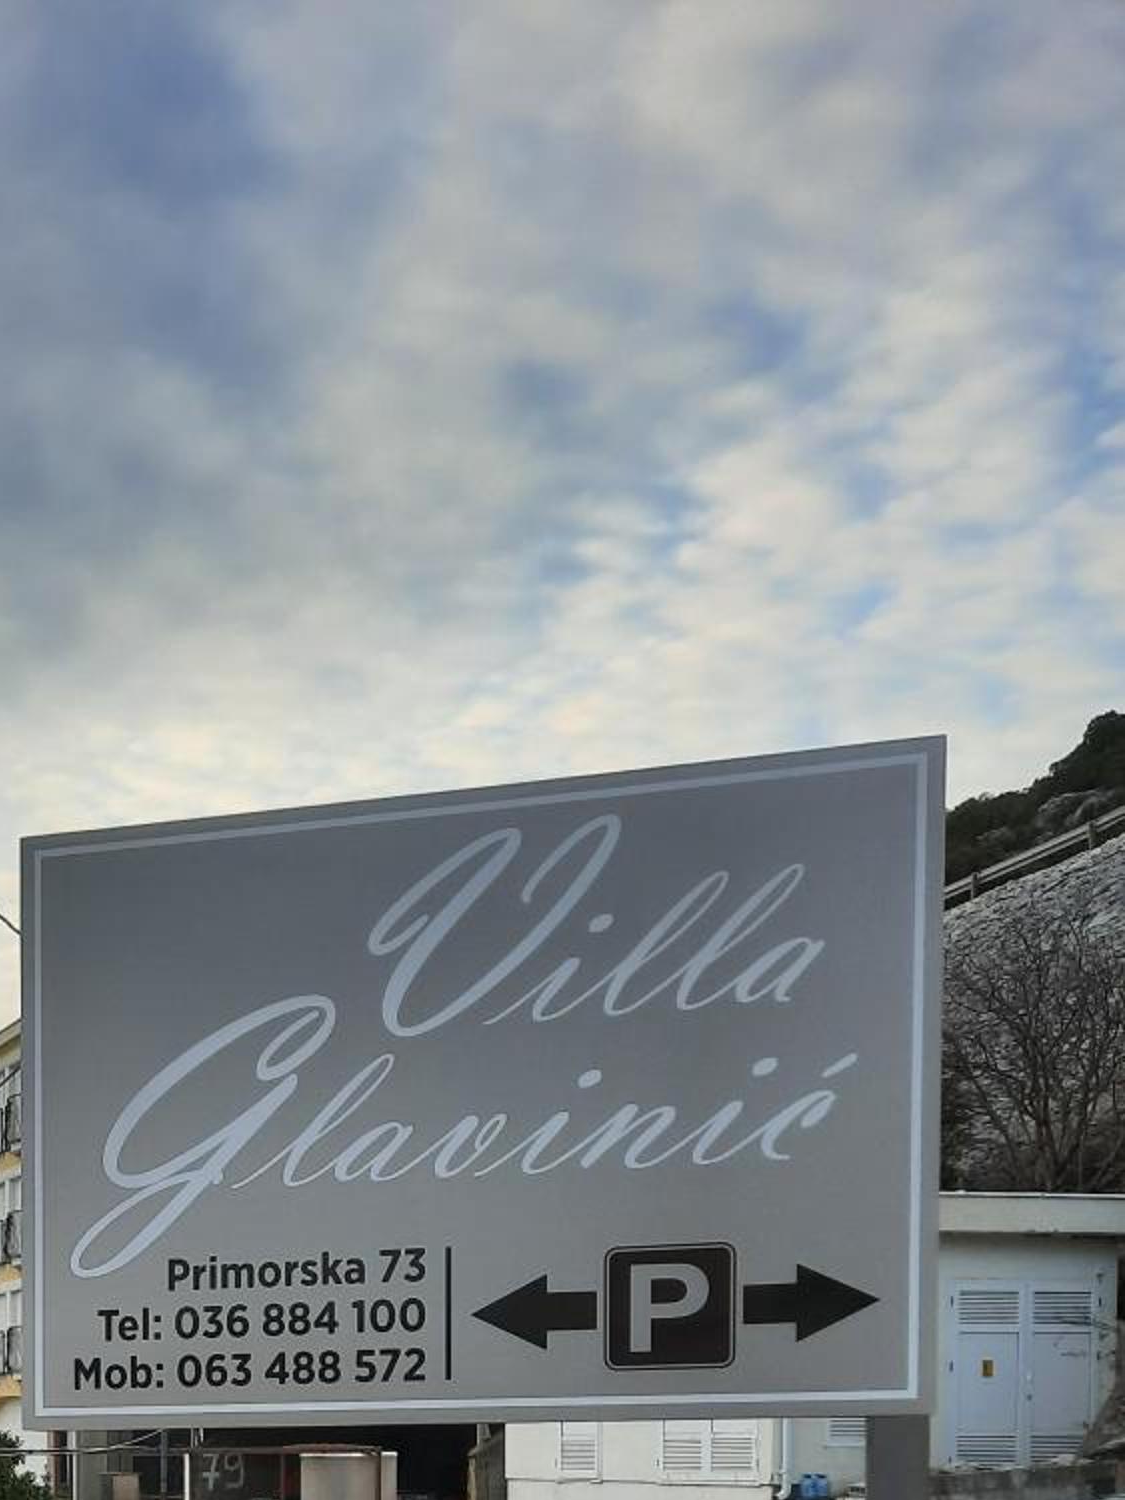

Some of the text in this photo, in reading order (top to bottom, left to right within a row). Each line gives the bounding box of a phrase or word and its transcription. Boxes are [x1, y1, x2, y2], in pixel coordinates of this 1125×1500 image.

[366, 814, 826, 1037] Villa
[70, 994, 858, 1279] Glavinić
[168, 1247, 426, 1291] Primorska 73
[97, 1297, 426, 1342] Tel: 036 884 100
[631, 1263, 709, 1353] P
[74, 1347, 426, 1391] Mob: 063 488 572
